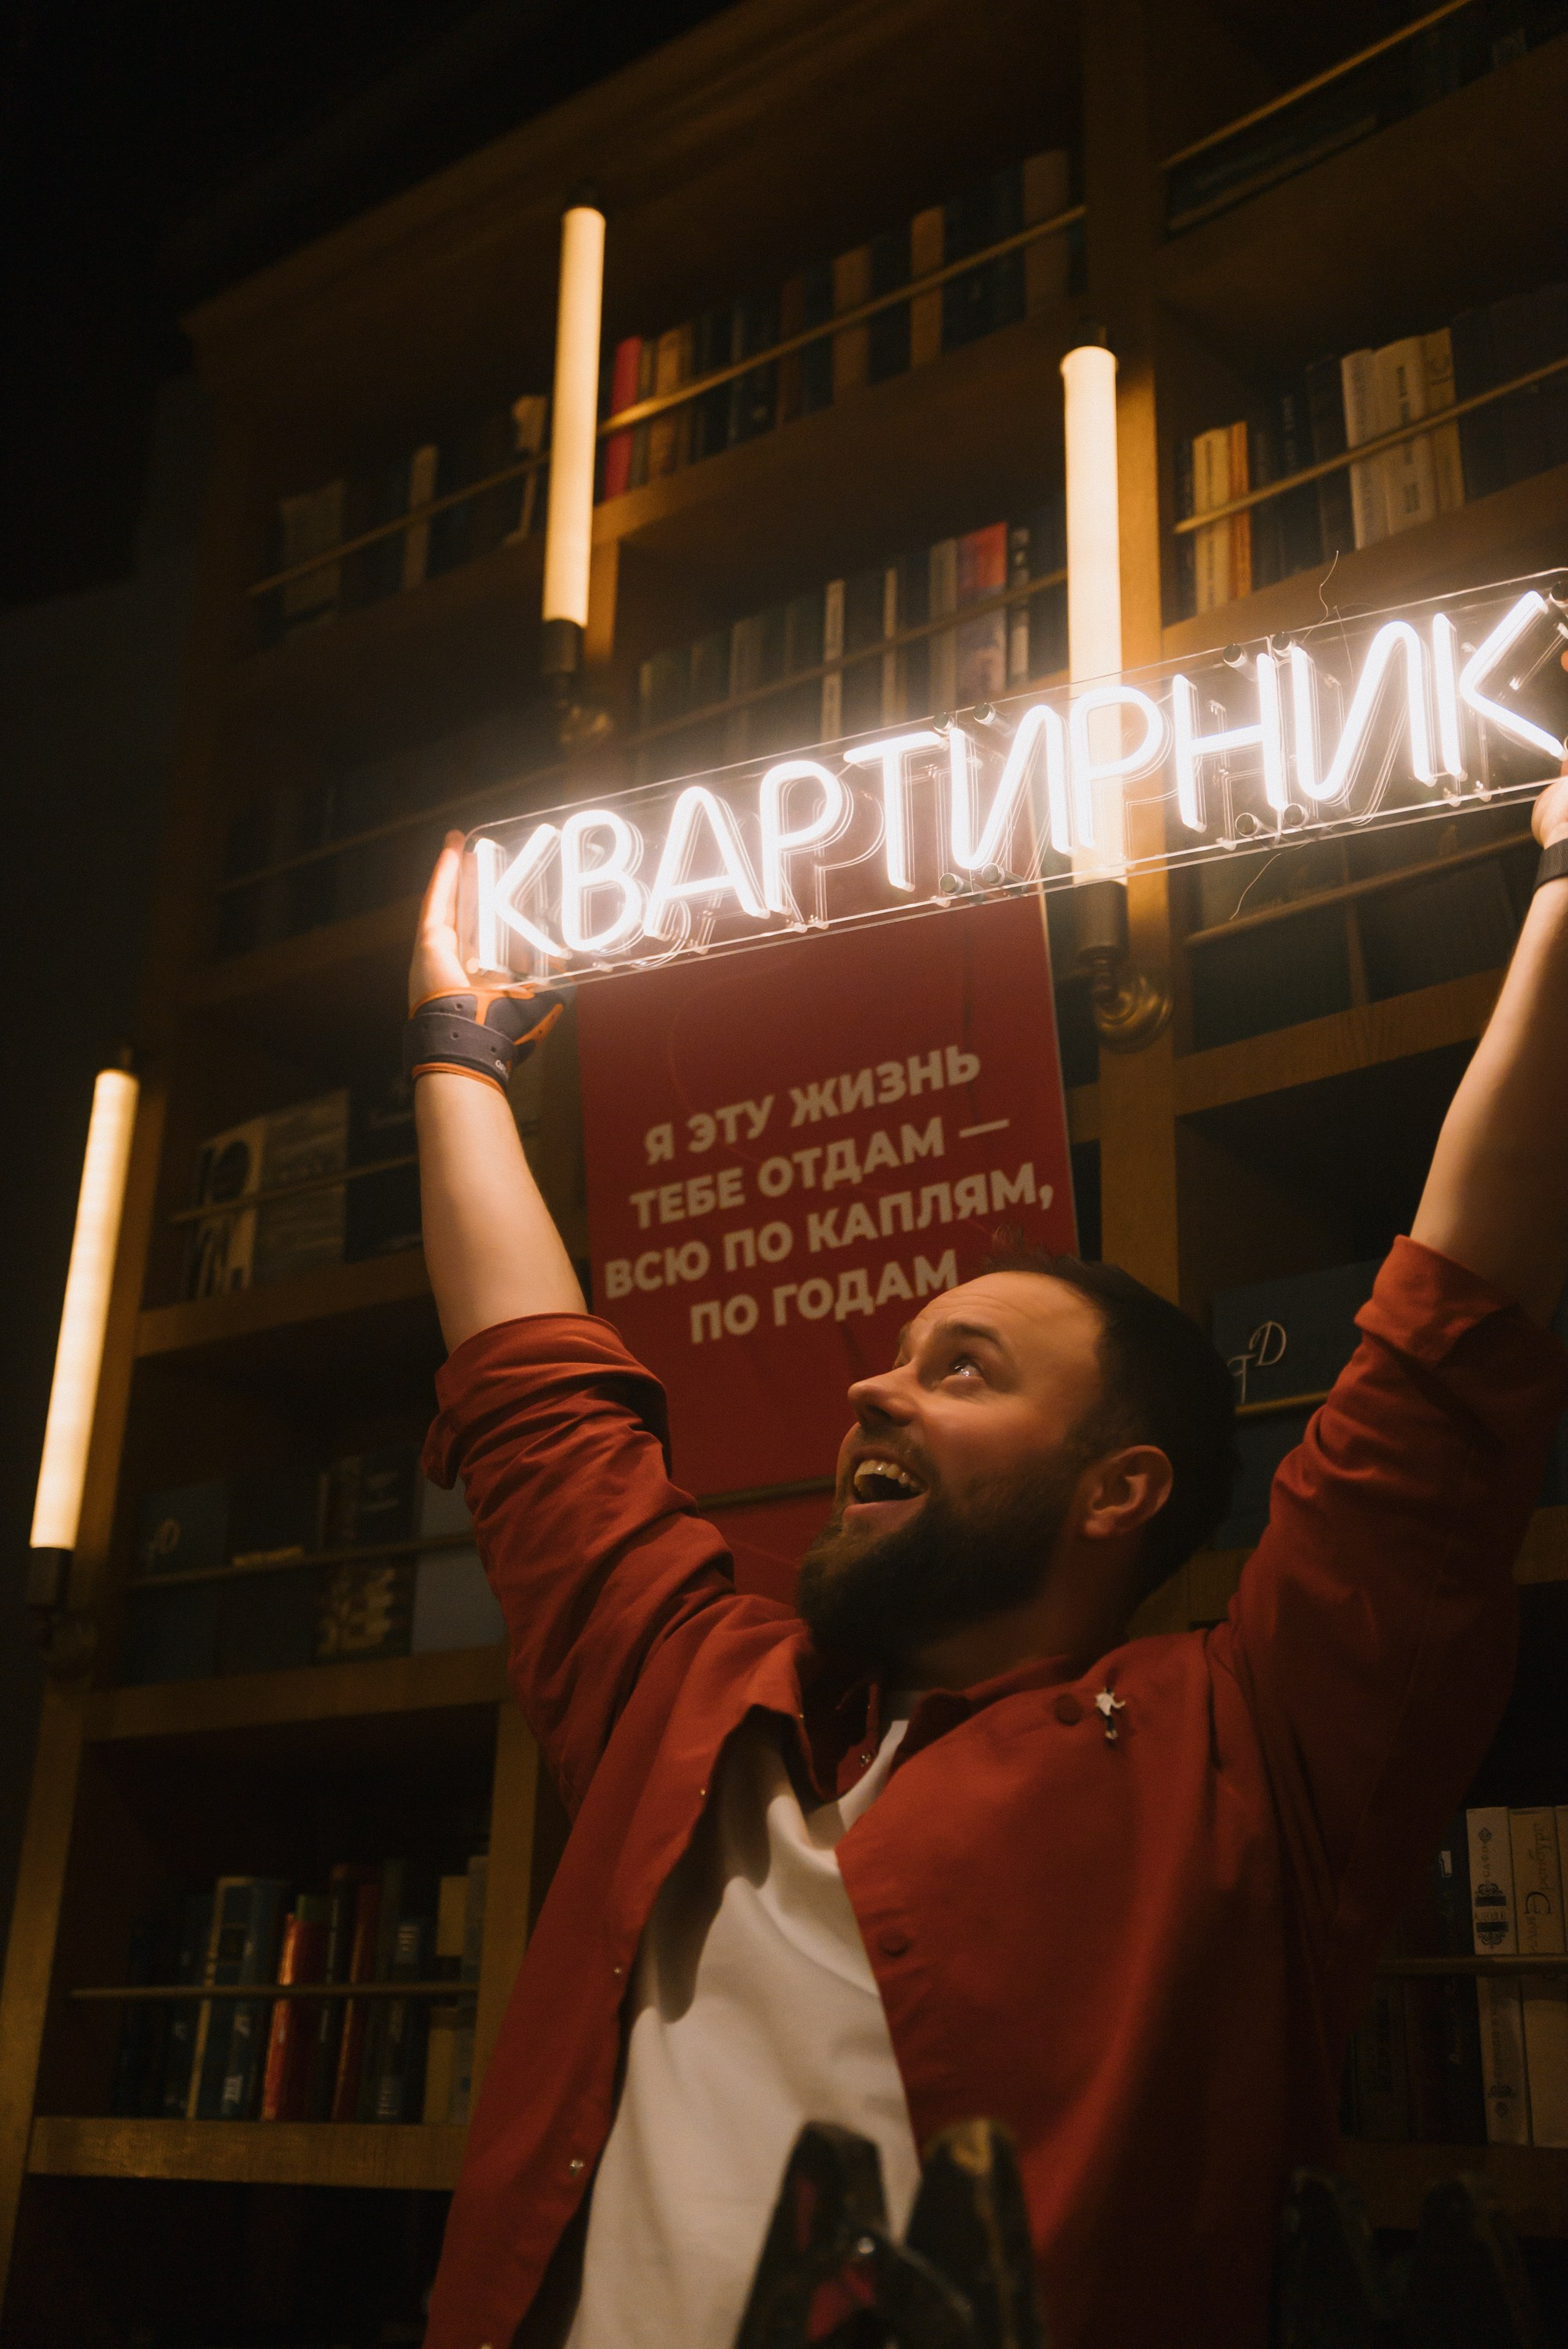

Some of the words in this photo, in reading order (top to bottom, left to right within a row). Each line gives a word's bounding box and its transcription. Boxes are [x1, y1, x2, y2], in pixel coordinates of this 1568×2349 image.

[474, 590, 1566, 972] КВАРТИРНИК
[643, 1123, 676, 1165] Я
[687, 1094, 775, 1154] ЭТУ
[788, 1044, 982, 1128] ЖИЗНЬ
[604, 1241, 711, 1300] ВСЮ
[723, 1221, 793, 1272] ПО
[806, 1162, 1054, 1254] КАПЛЯМ,
[629, 1167, 745, 1229] ТЕБЕ
[757, 1117, 946, 1198] ОТДАМ
[689, 1294, 759, 1344] ПО
[772, 1249, 960, 1327] ГОДАМ
